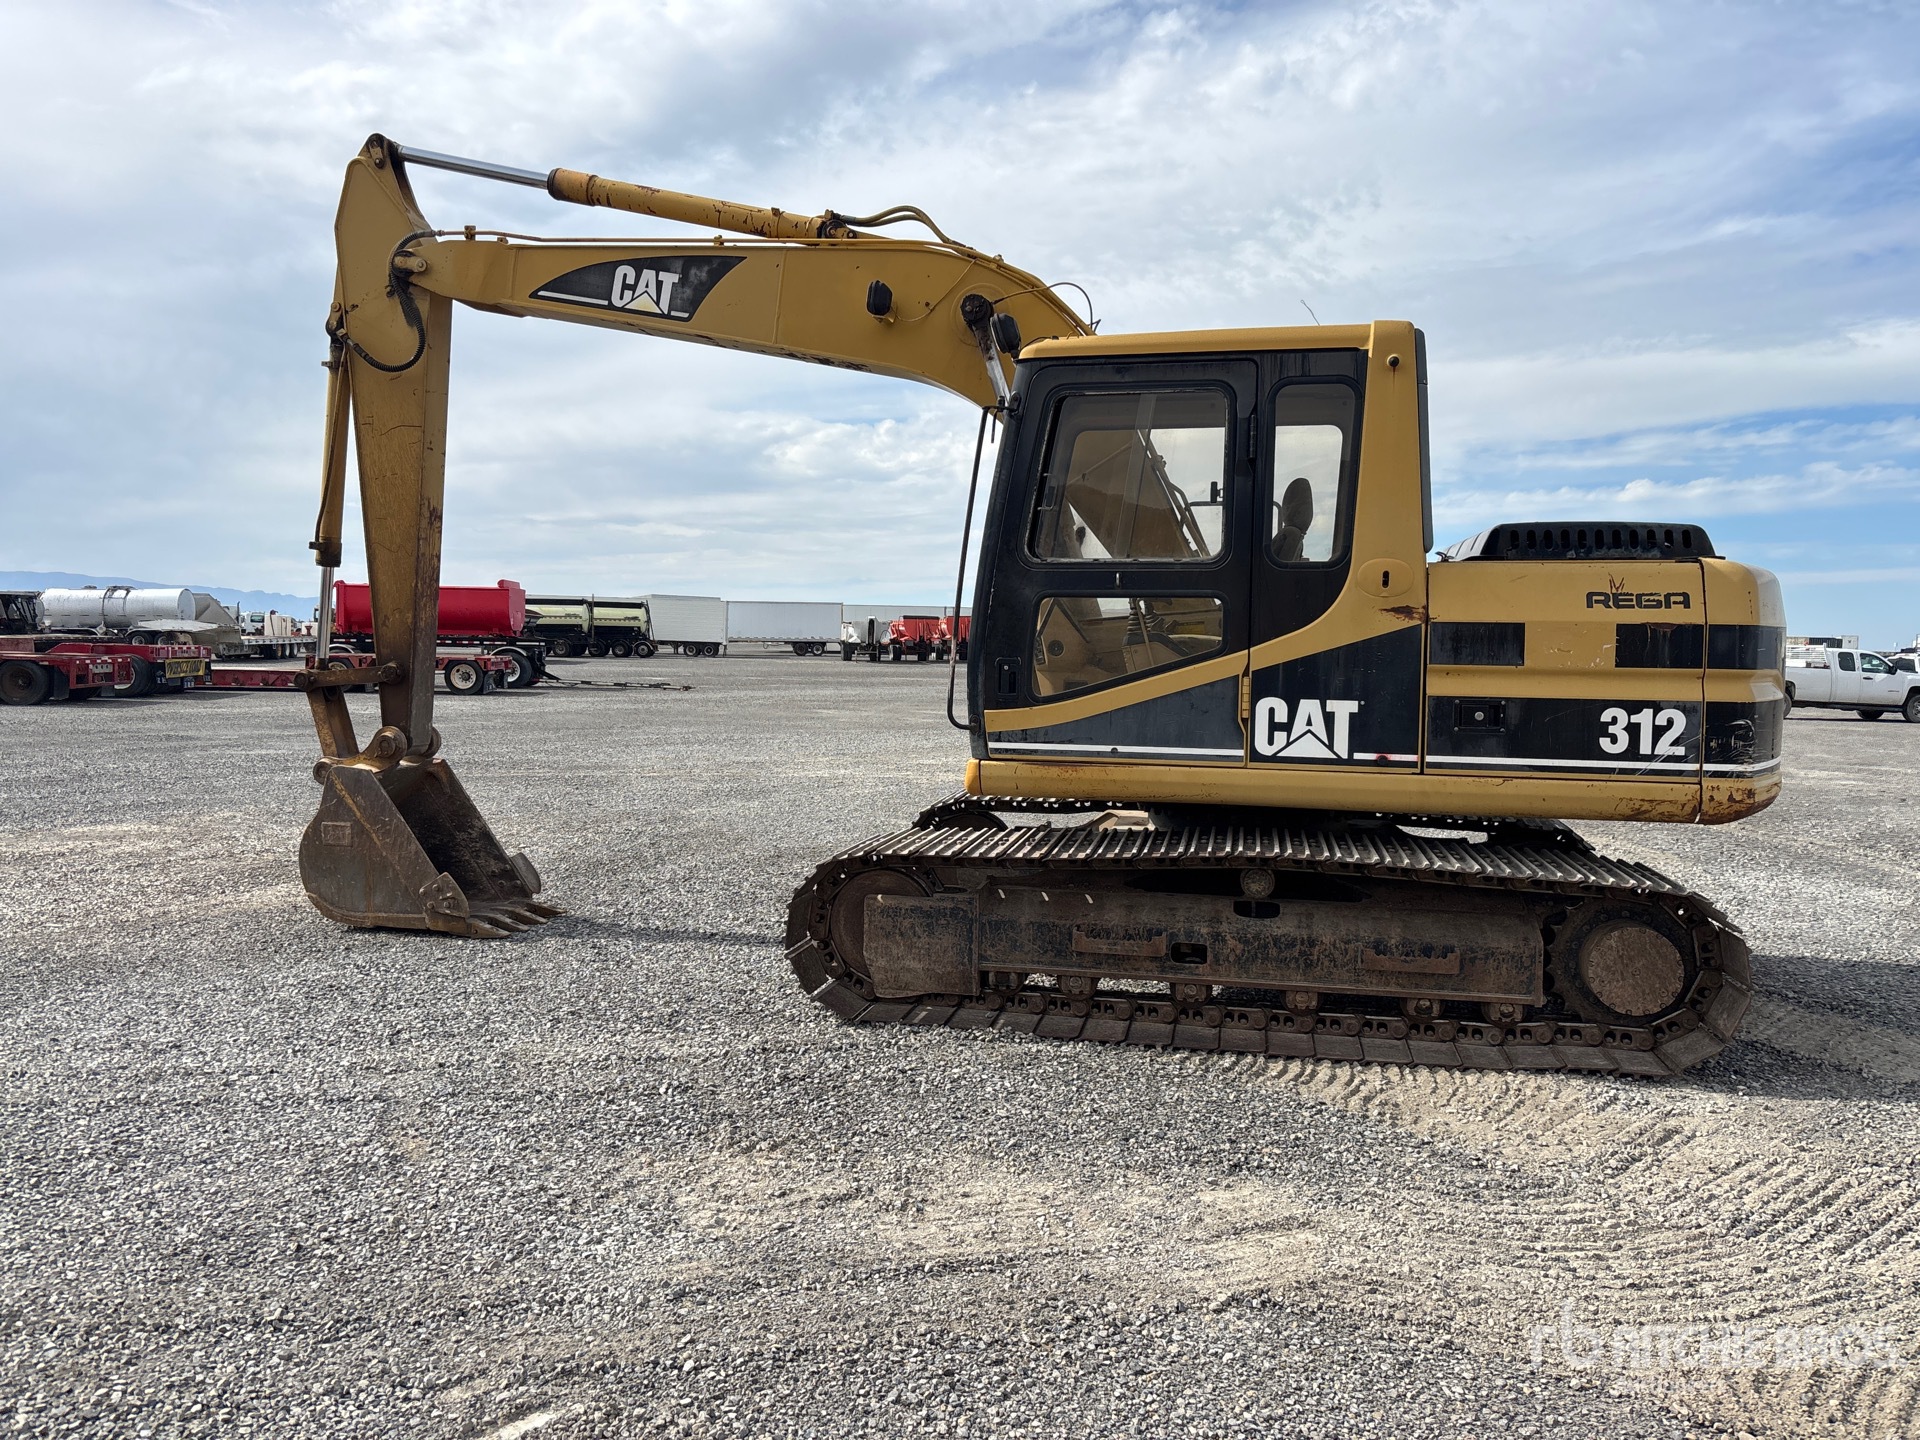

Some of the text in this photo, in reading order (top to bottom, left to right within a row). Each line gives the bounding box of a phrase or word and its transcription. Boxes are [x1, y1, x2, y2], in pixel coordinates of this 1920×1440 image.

[611, 265, 679, 314] CAT
[1586, 591, 1691, 609] REGA
[1254, 696, 1359, 759] CAT
[1599, 707, 1687, 756] 312
